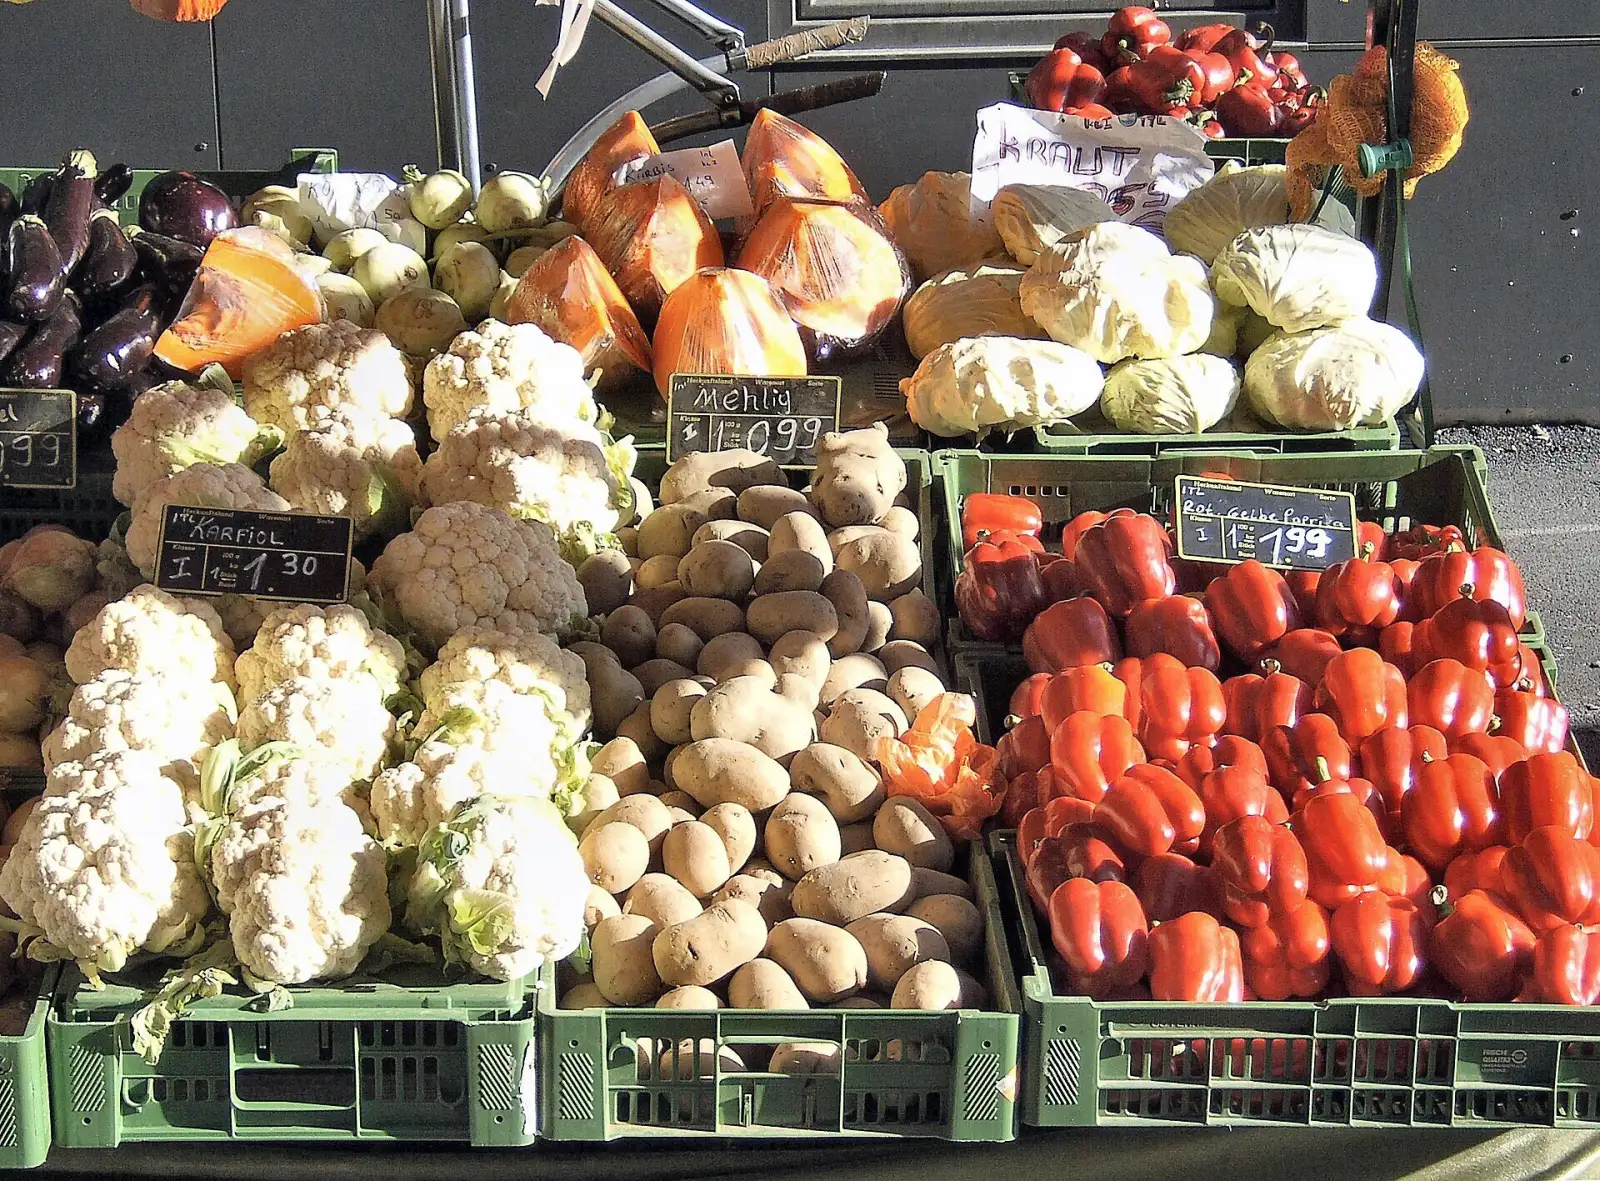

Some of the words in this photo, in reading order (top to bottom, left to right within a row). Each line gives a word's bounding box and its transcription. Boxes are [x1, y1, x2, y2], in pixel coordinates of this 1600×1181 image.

[1000, 121, 1141, 176] KRAUT
[693, 386, 791, 415] Mehlig
[1182, 486, 1205, 496] ITL
[1226, 523, 1237, 549] 1
[169, 556, 191, 579] I
[210, 566, 220, 579] 1
